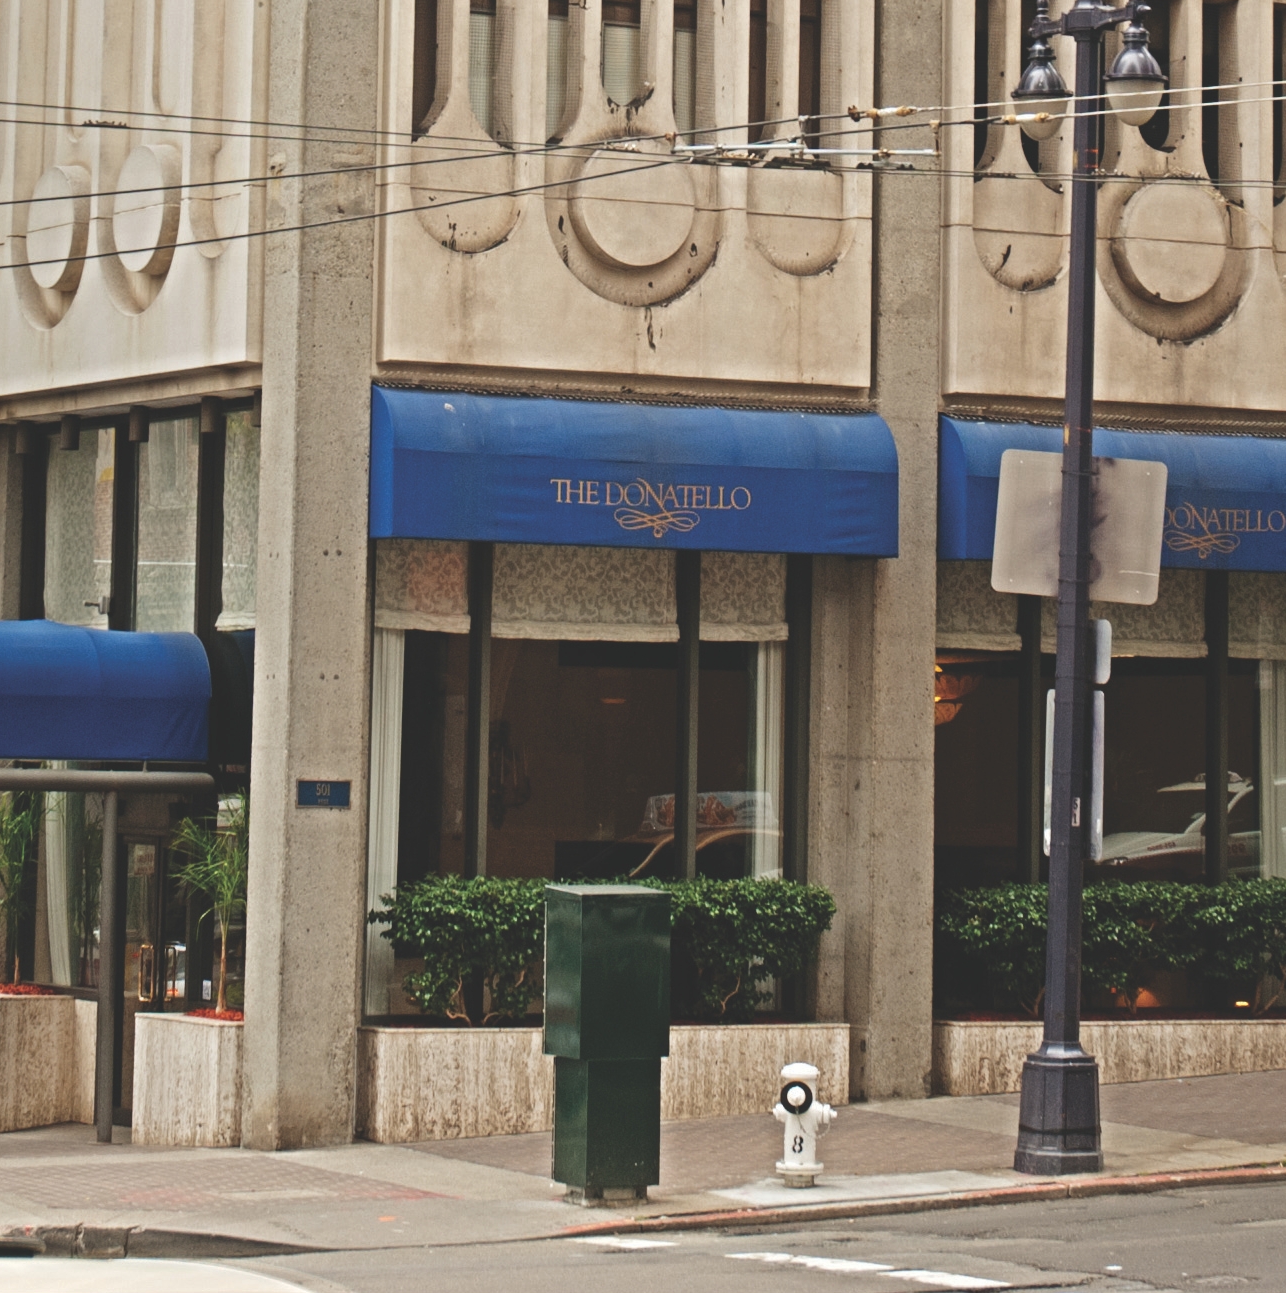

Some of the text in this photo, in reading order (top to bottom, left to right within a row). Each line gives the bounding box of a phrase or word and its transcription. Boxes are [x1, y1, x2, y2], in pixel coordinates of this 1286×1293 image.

[550, 477, 752, 510] THE DONATELLO
[315, 783, 331, 796] 501
[792, 1135, 804, 1154] 8
